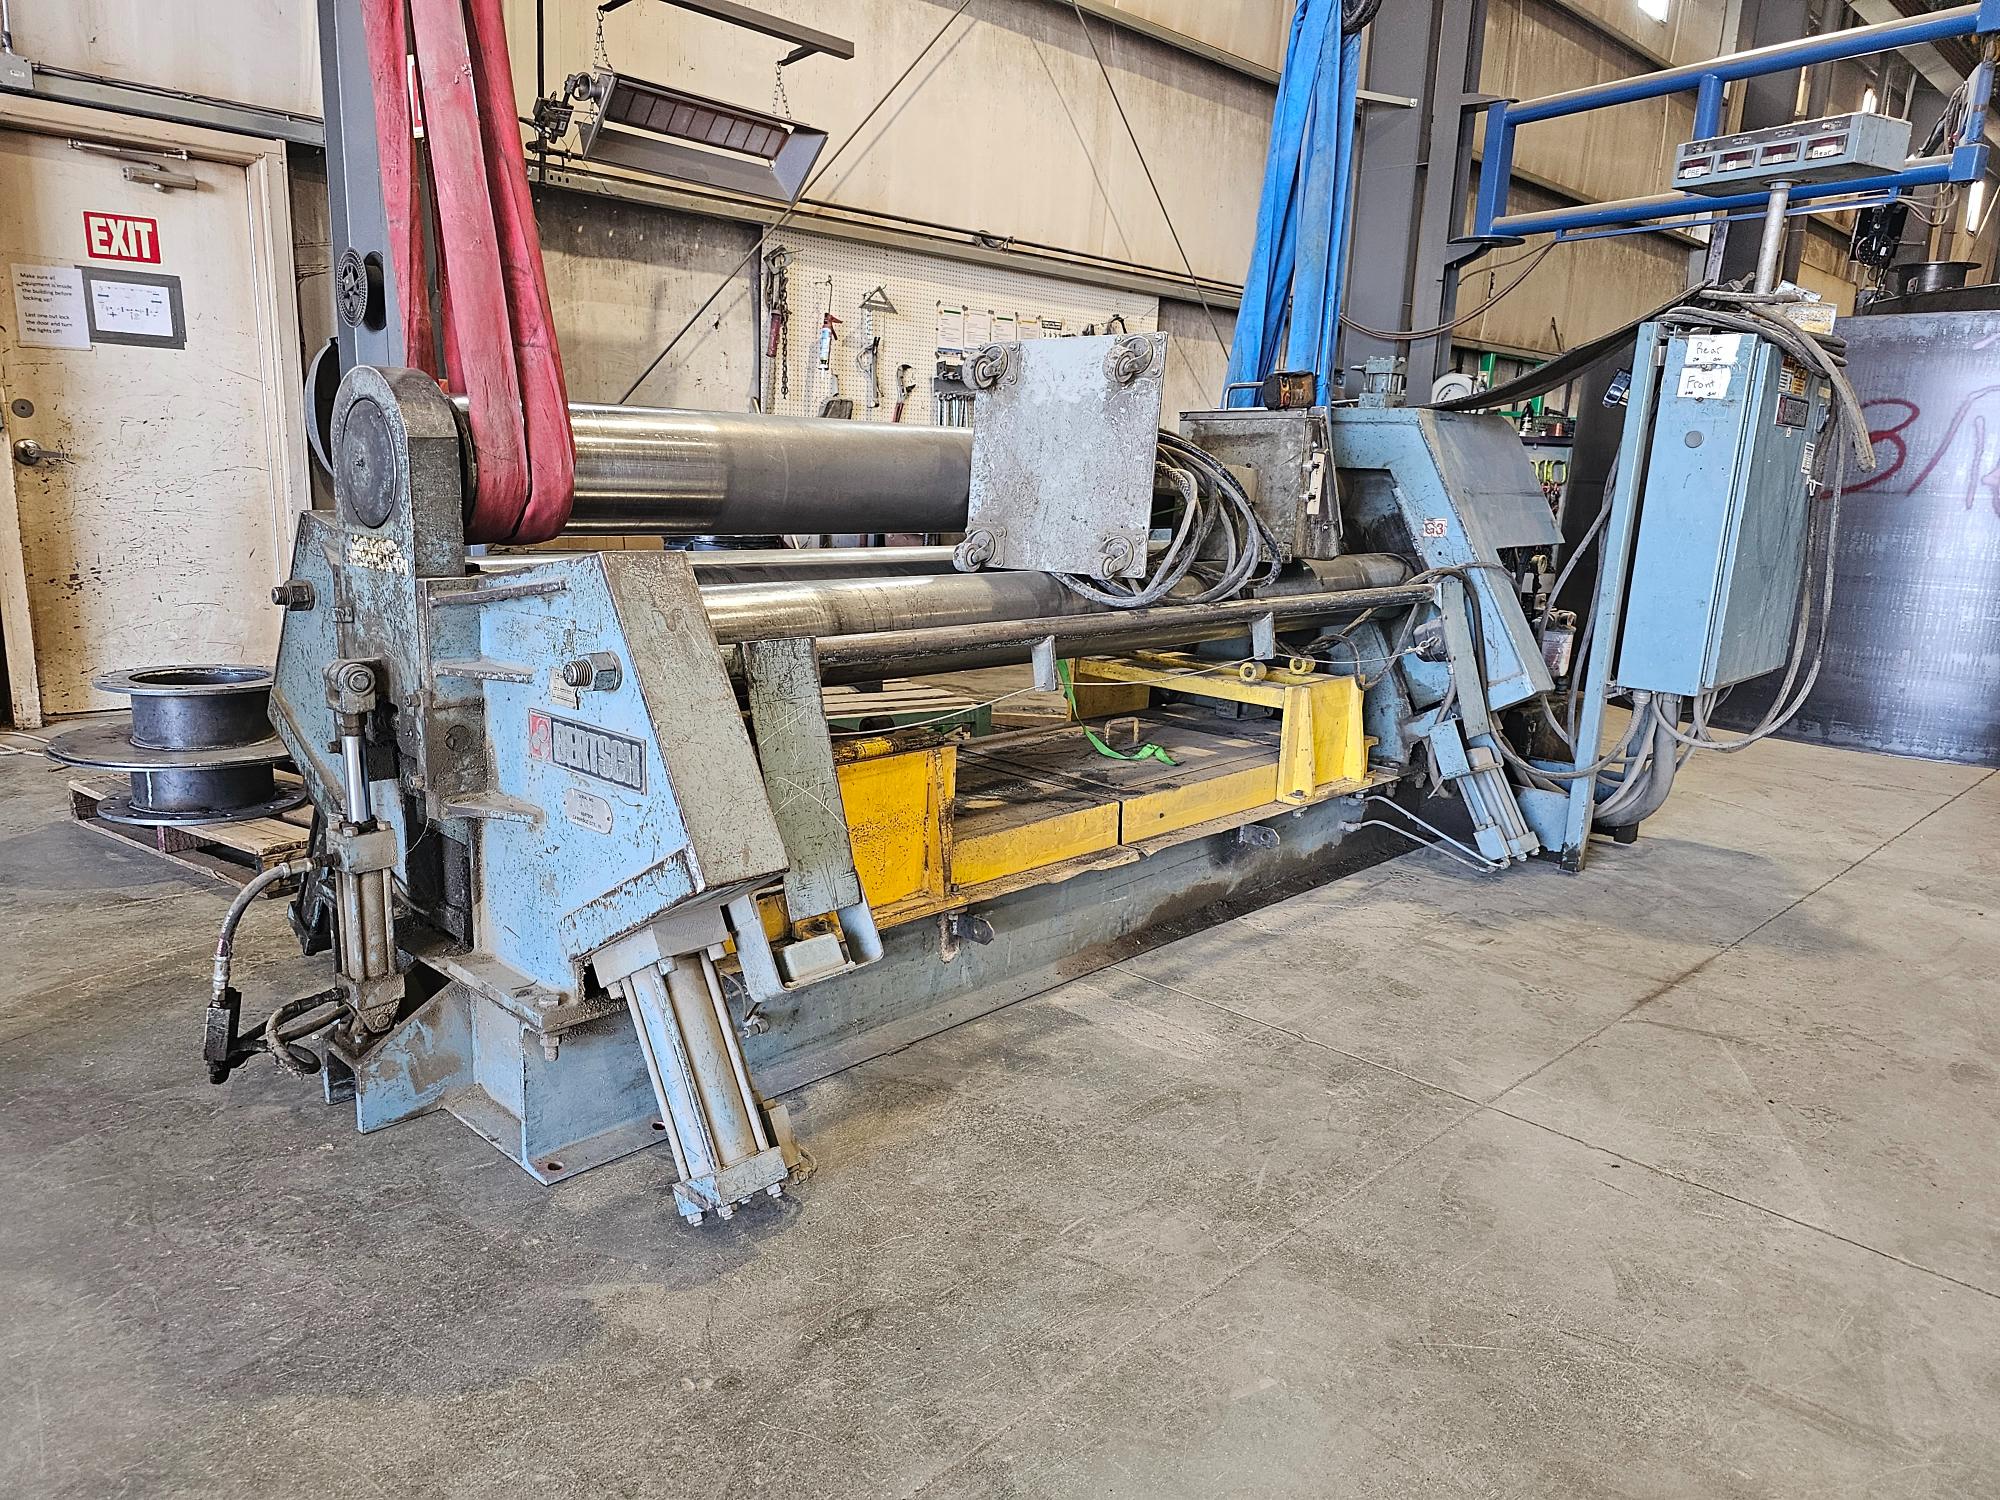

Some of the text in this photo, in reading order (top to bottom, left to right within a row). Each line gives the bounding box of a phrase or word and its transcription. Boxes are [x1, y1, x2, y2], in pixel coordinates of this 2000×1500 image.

[89, 216, 153, 259] EXIT
[1697, 341, 1723, 355] Rear
[1425, 522, 1443, 535] G3
[552, 721, 641, 788] BERTSCH
